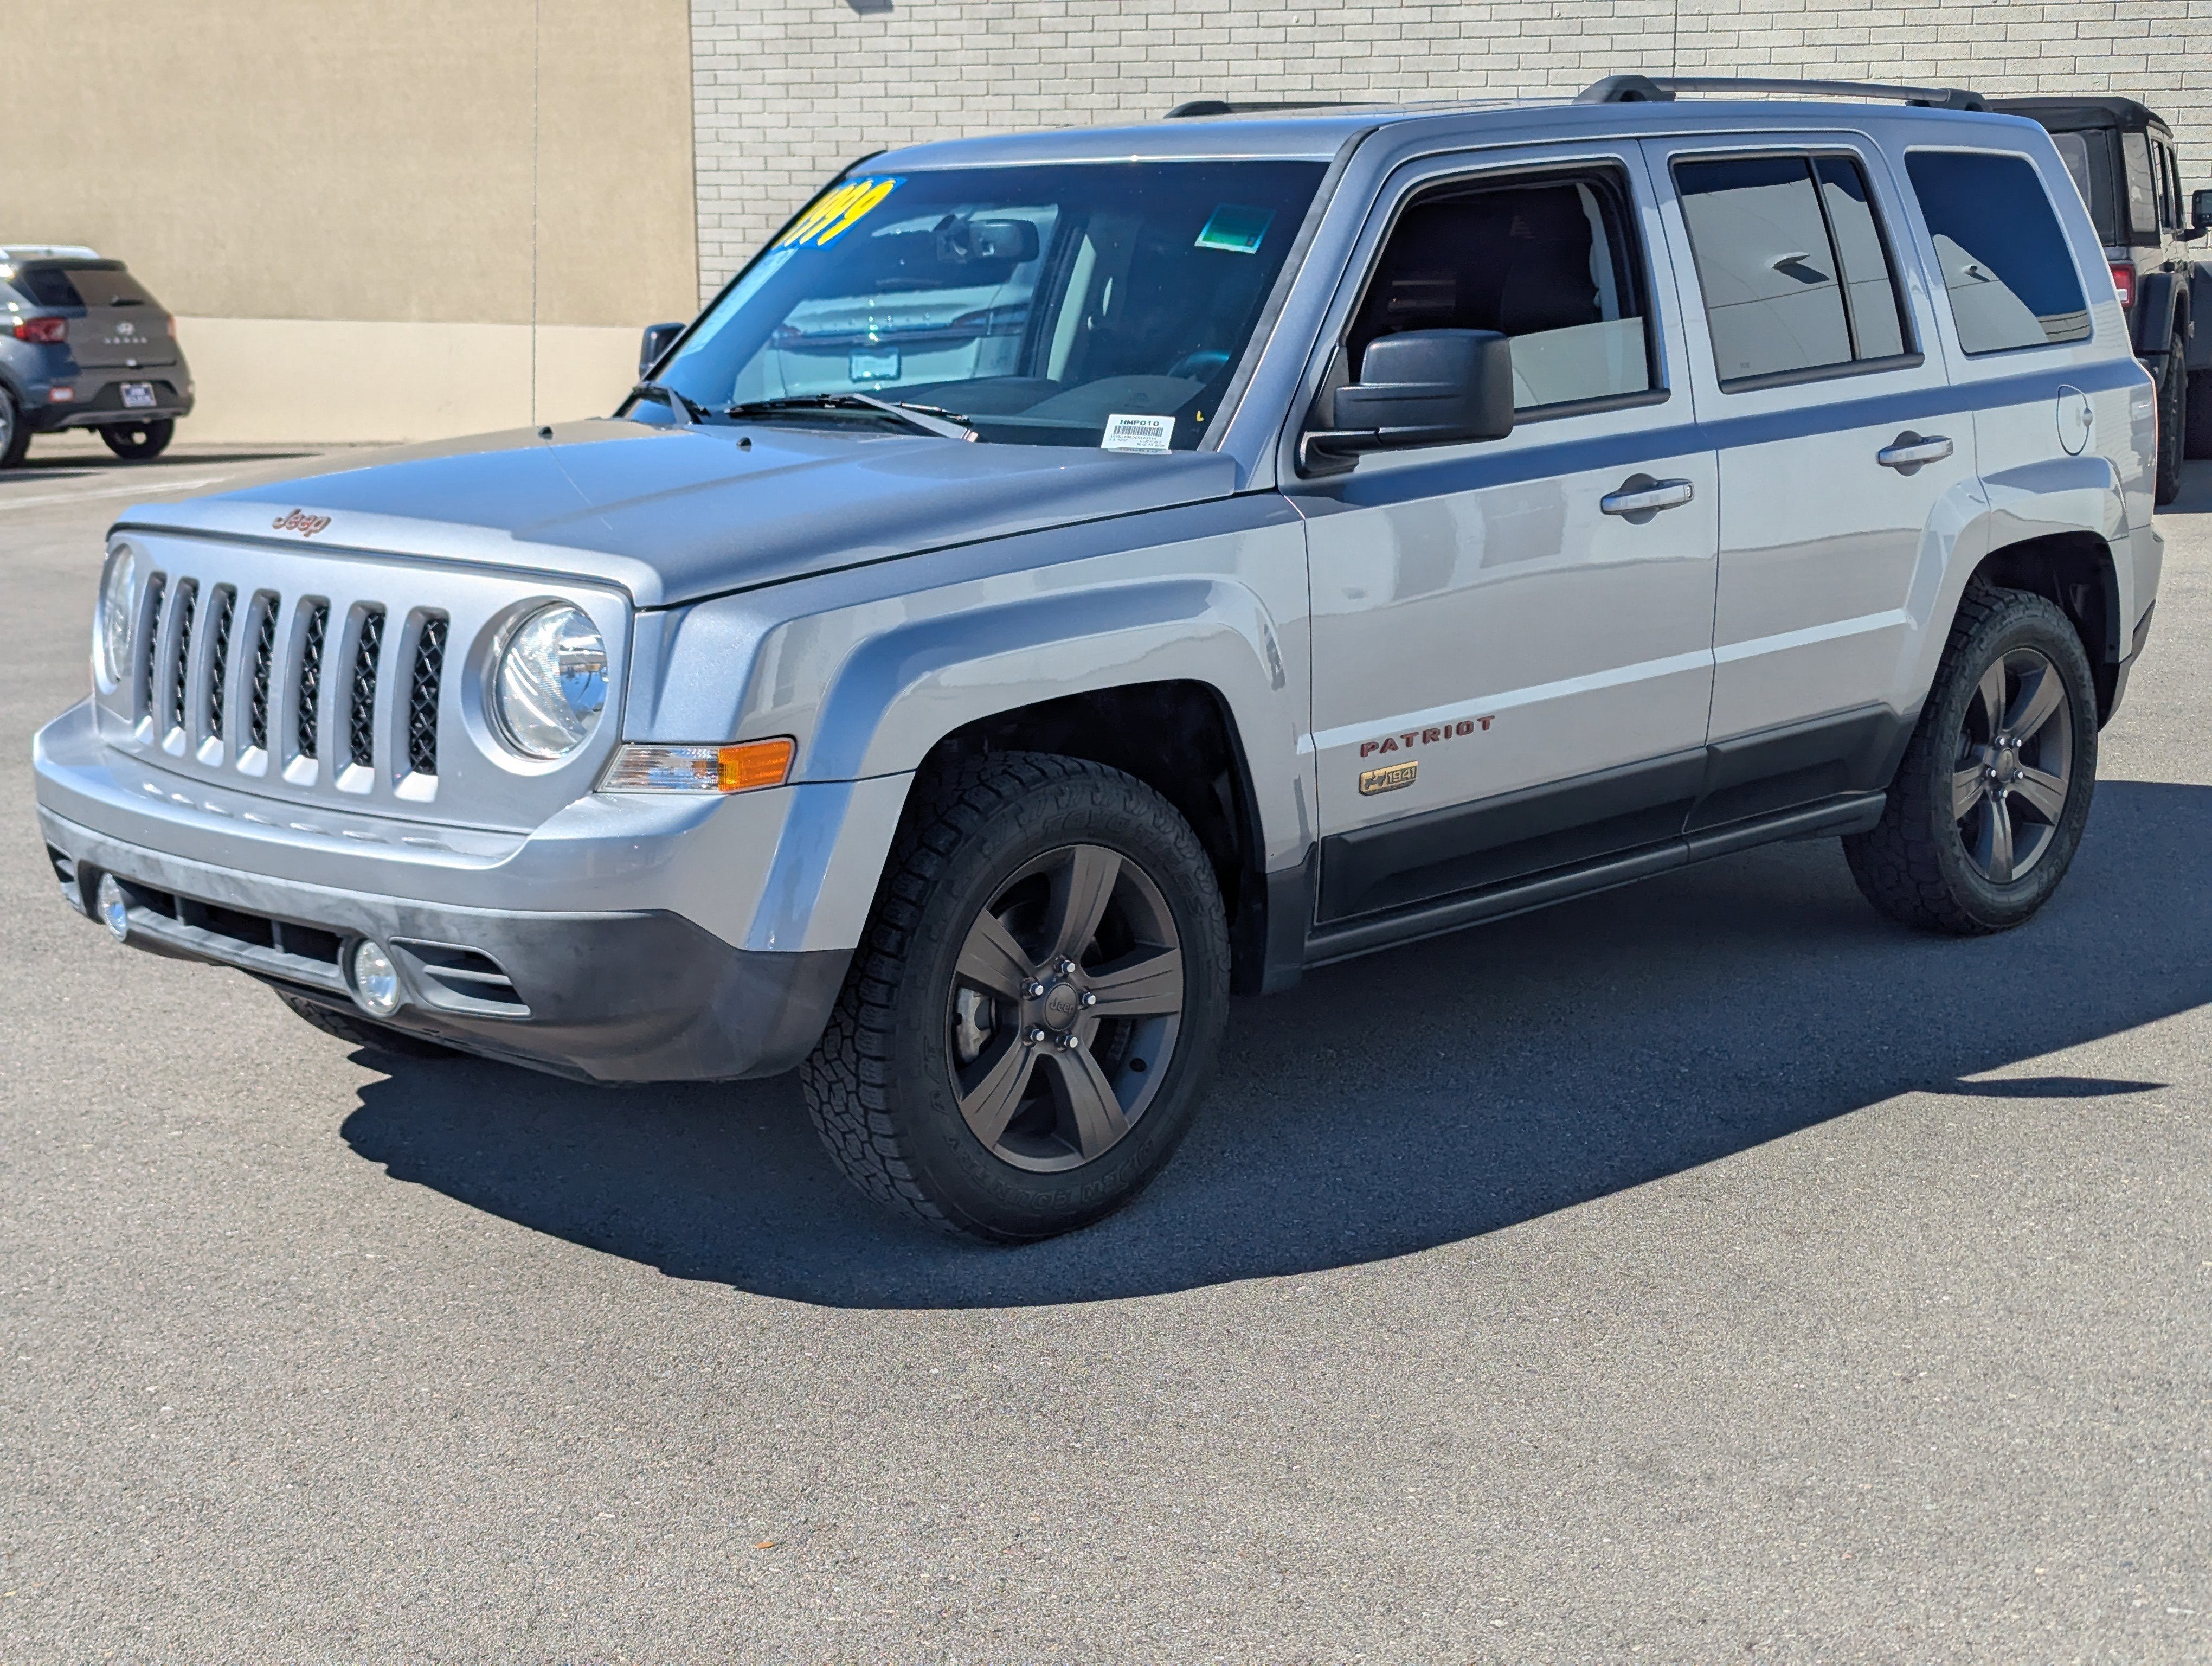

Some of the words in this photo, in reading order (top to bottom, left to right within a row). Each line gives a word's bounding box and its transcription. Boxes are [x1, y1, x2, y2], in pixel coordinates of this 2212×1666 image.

[272, 508, 332, 537] Jeep
[1360, 715, 1495, 758] PATRIOT
[1388, 767, 1416, 784] 1941
[1049, 998, 1074, 1013] Jeep
